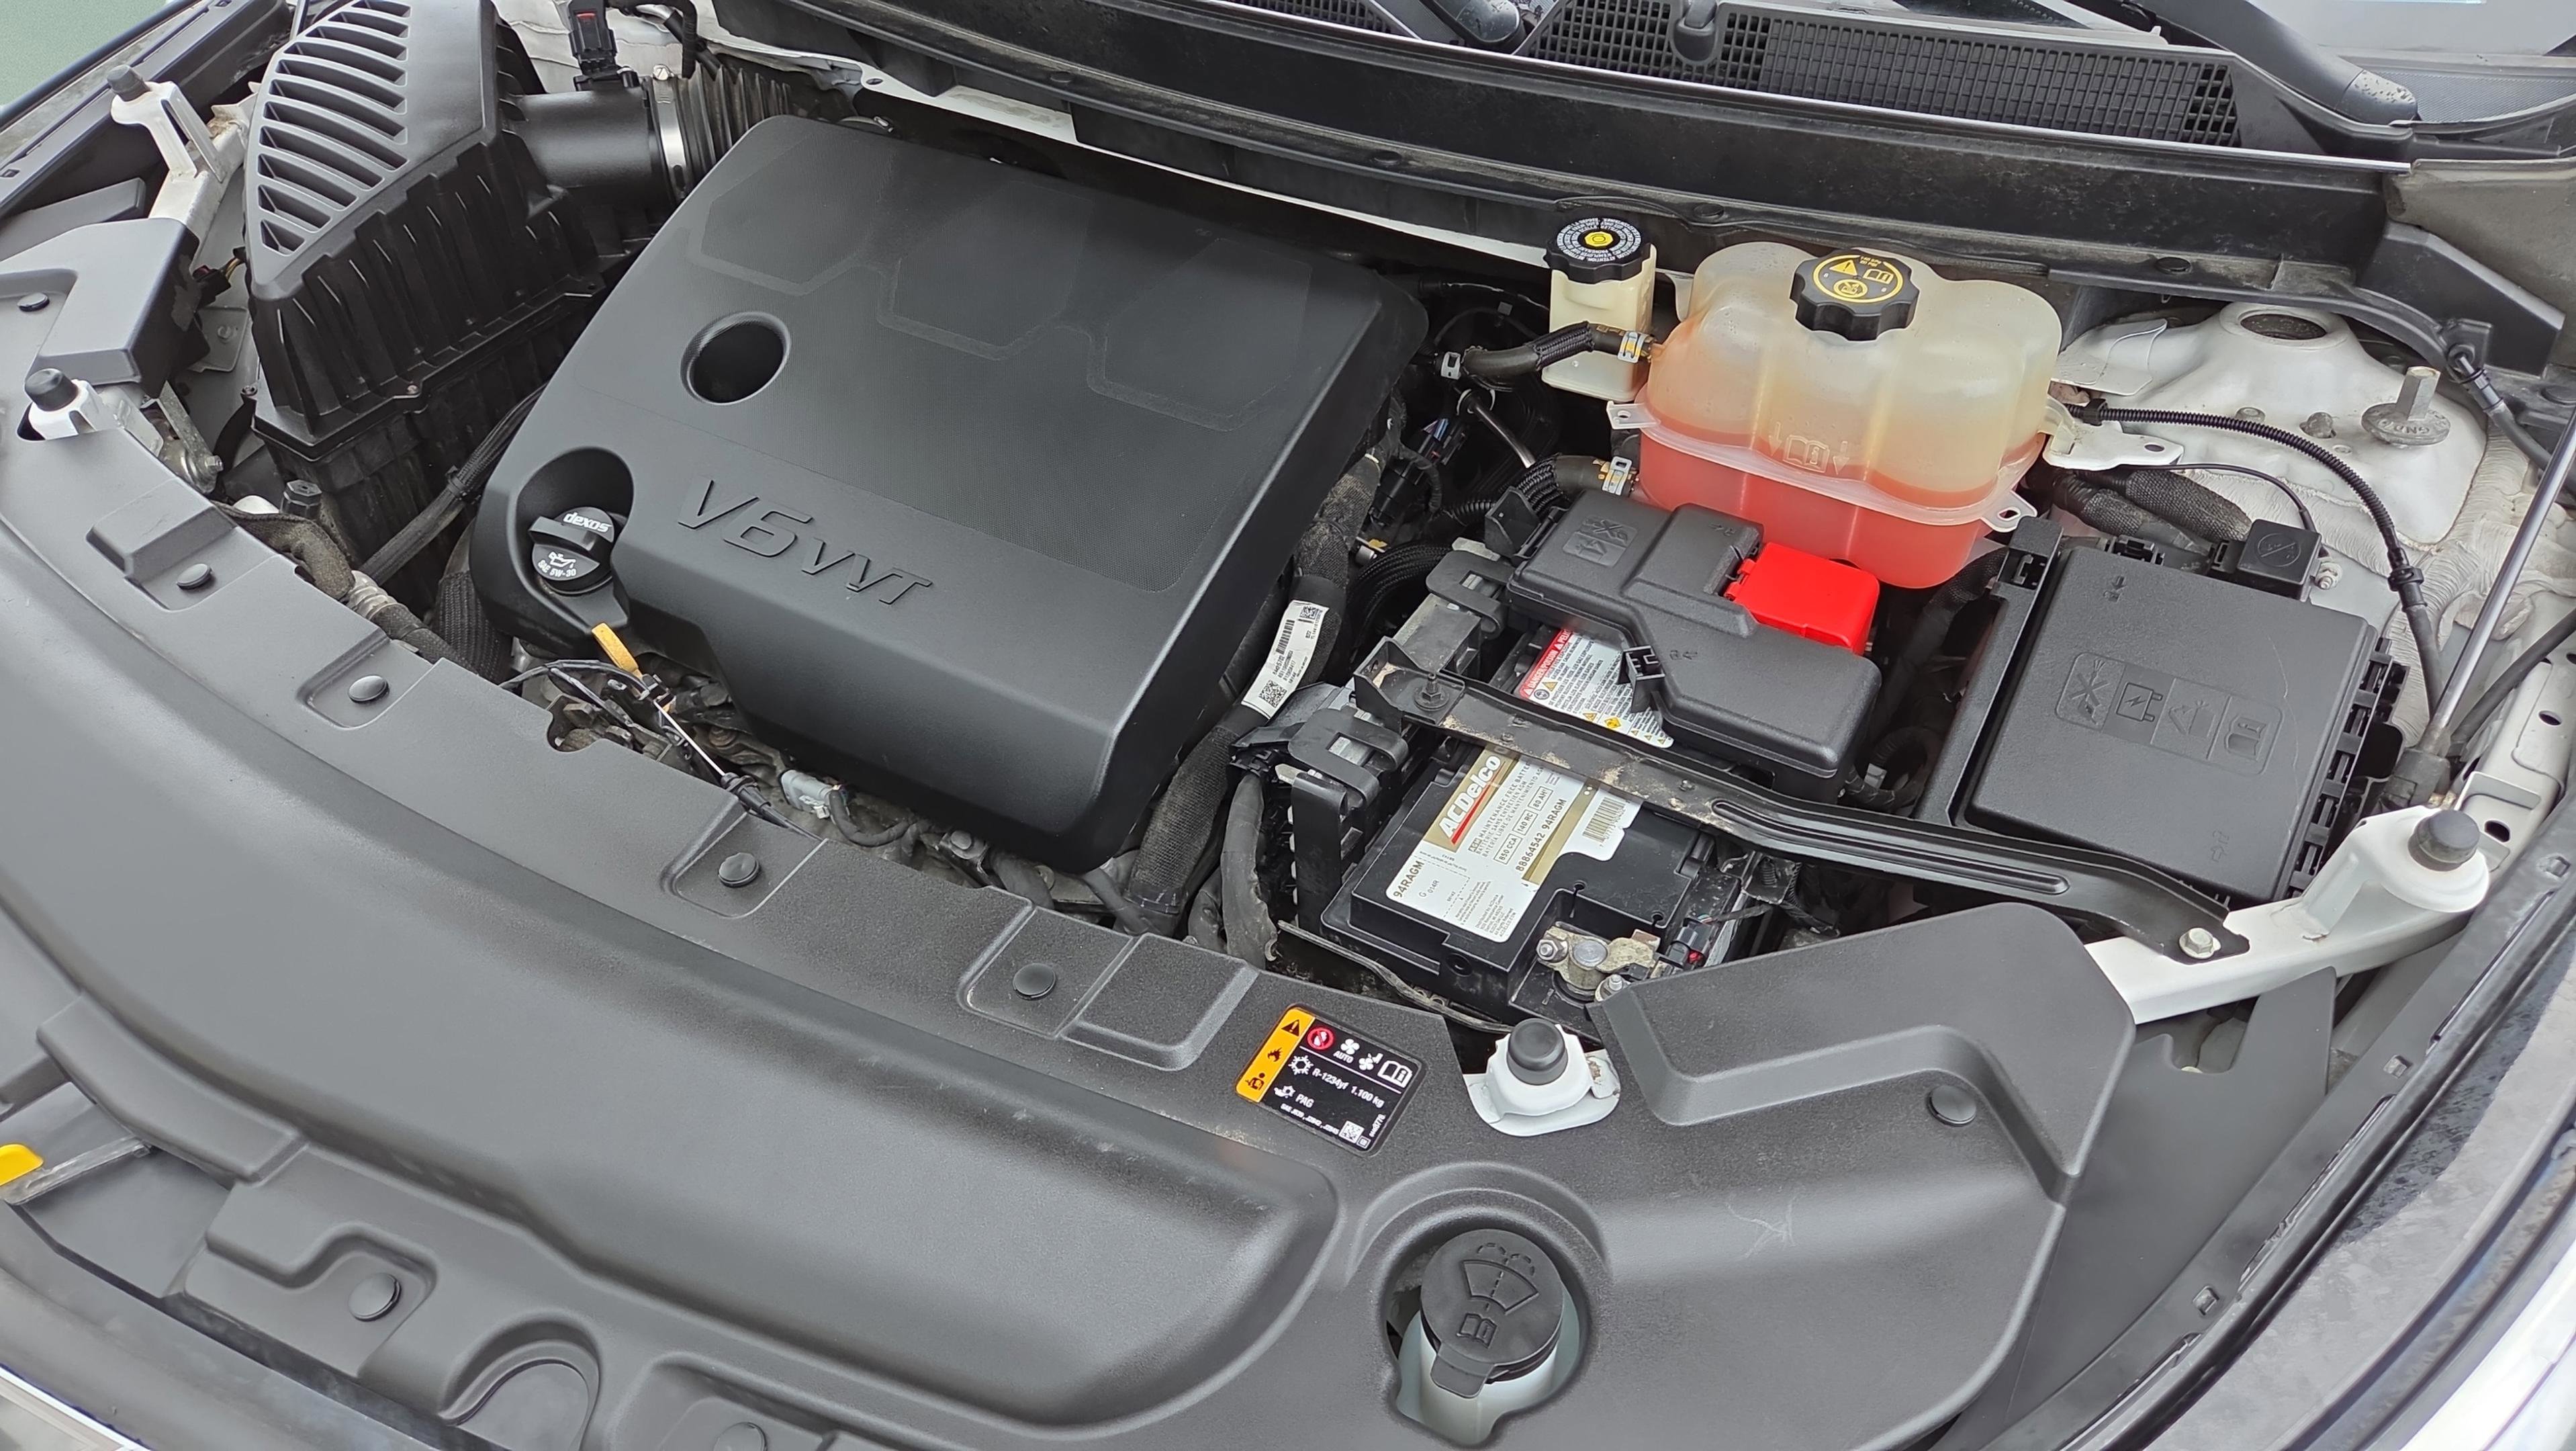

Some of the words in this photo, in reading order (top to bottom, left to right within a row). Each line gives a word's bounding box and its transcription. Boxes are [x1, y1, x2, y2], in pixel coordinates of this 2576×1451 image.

[563, 512, 612, 533] dexos
[538, 560, 551, 573] SAE
[549, 568, 577, 577] 5W-30
[1526, 647, 1560, 691] DANGER/POISON
[1437, 750, 1504, 840] ACDelco
[1532, 799, 1543, 808] 80
[1478, 797, 1508, 839] MAINTENANCE
[1504, 782, 1518, 799] FREE
[1505, 814, 1514, 822] DE
[1491, 817, 1504, 832] SANS
[1516, 820, 1528, 833] 140
[1523, 811, 1534, 822] RC
[1515, 831, 1547, 873] 88864542
[1540, 797, 1567, 832] 94RAGM
[1498, 848, 1511, 862] 850
[1505, 836, 1518, 850] CCA
[1392, 859, 1426, 899] 94RAGM
[1418, 889, 1428, 899] G
[1426, 878, 1440, 895] 014R
[1333, 1051, 1354, 1064] AUTO
[1312, 1067, 1349, 1090] R-1234yf
[1350, 1086, 1374, 1102] 1.100
[1373, 1094, 1385, 1108] kg
[1295, 1093, 1314, 1108] PAG
